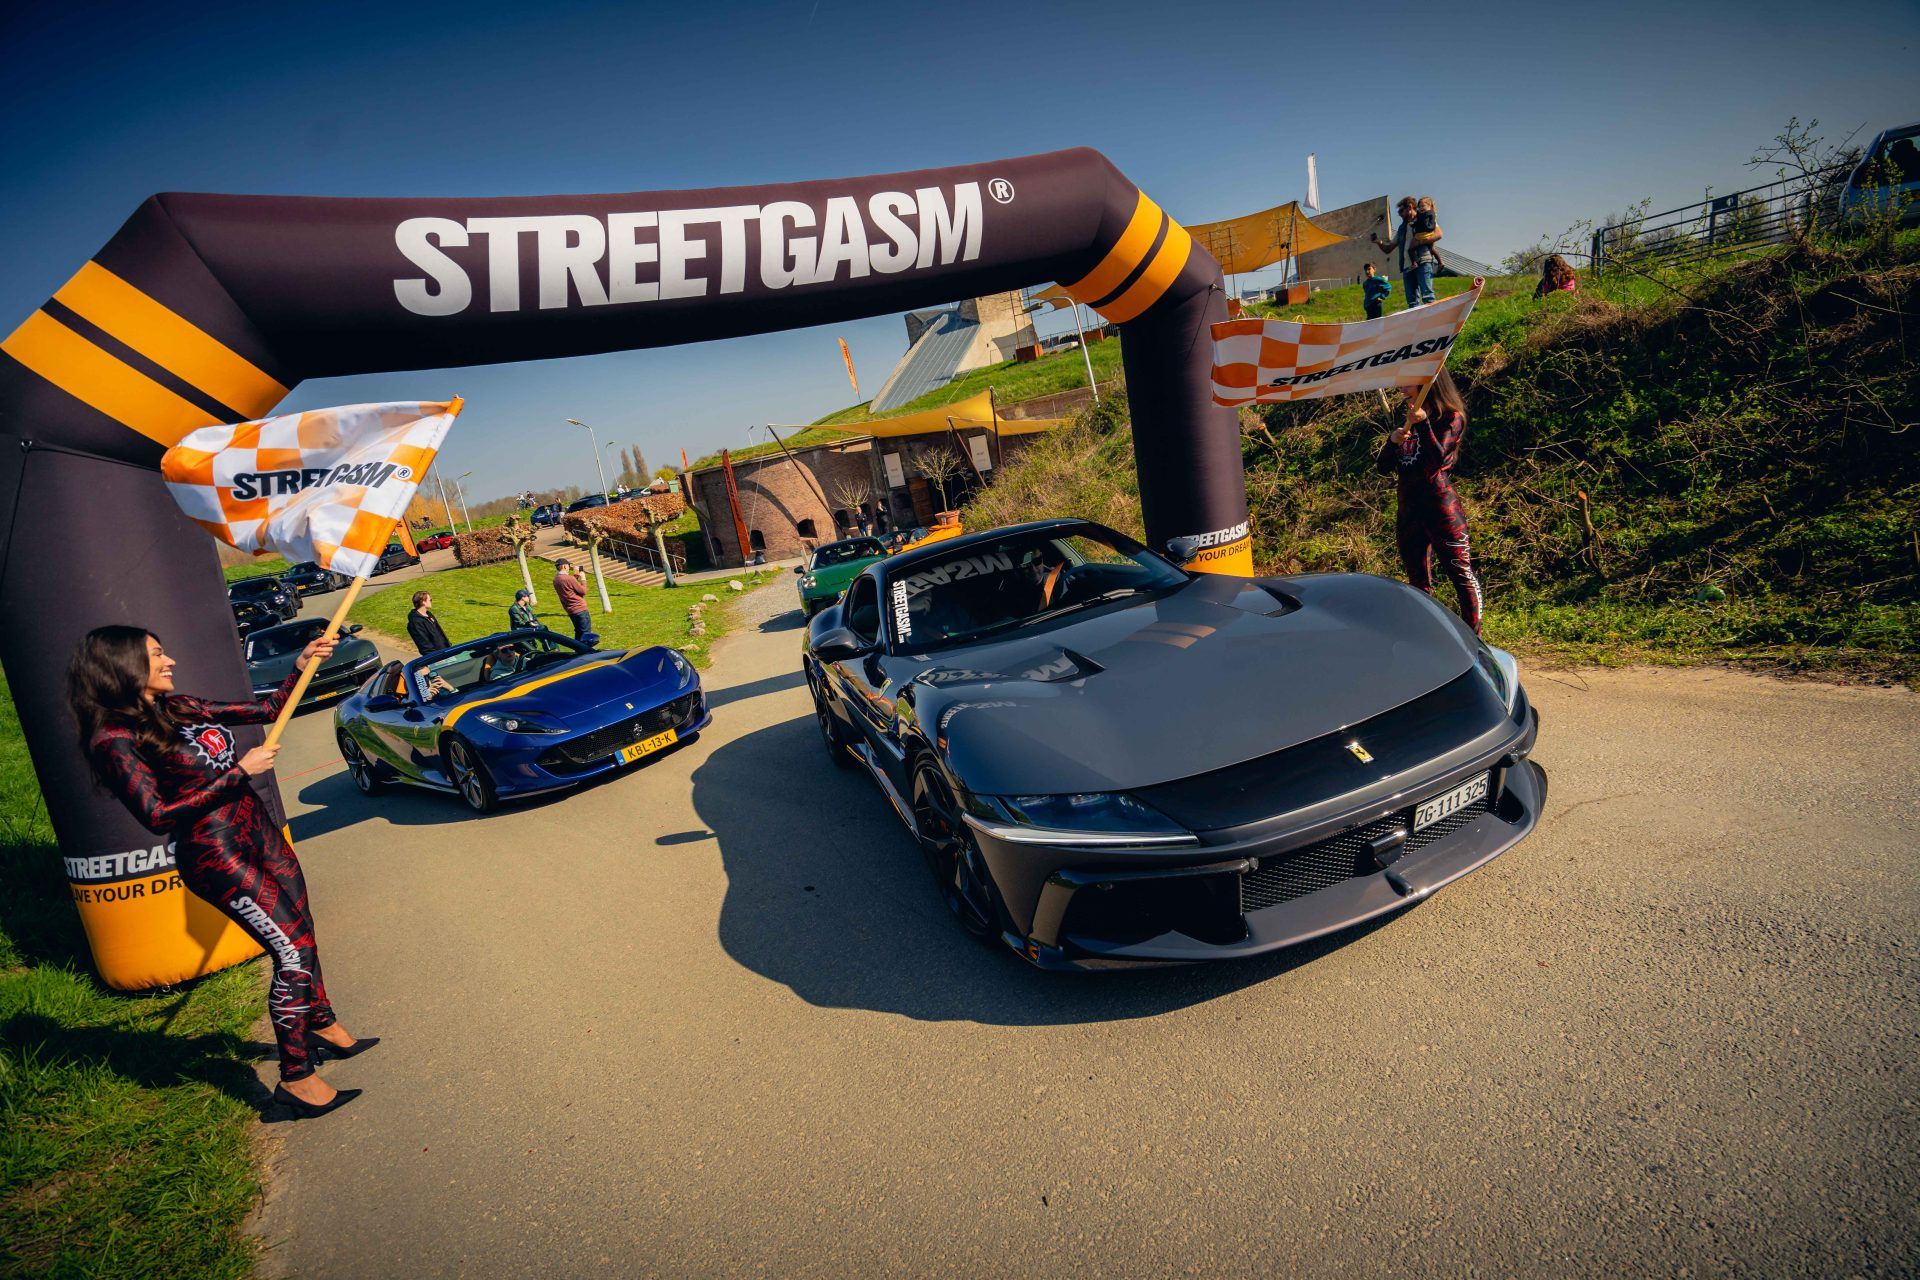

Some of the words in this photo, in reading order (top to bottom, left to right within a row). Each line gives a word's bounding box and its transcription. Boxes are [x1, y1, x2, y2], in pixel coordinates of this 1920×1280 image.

[1198, 550, 1227, 562] YOUR
[628, 733, 672, 759] KBL-13-K
[93, 883, 145, 903] YOUR
[229, 896, 301, 971] STREETGASM
